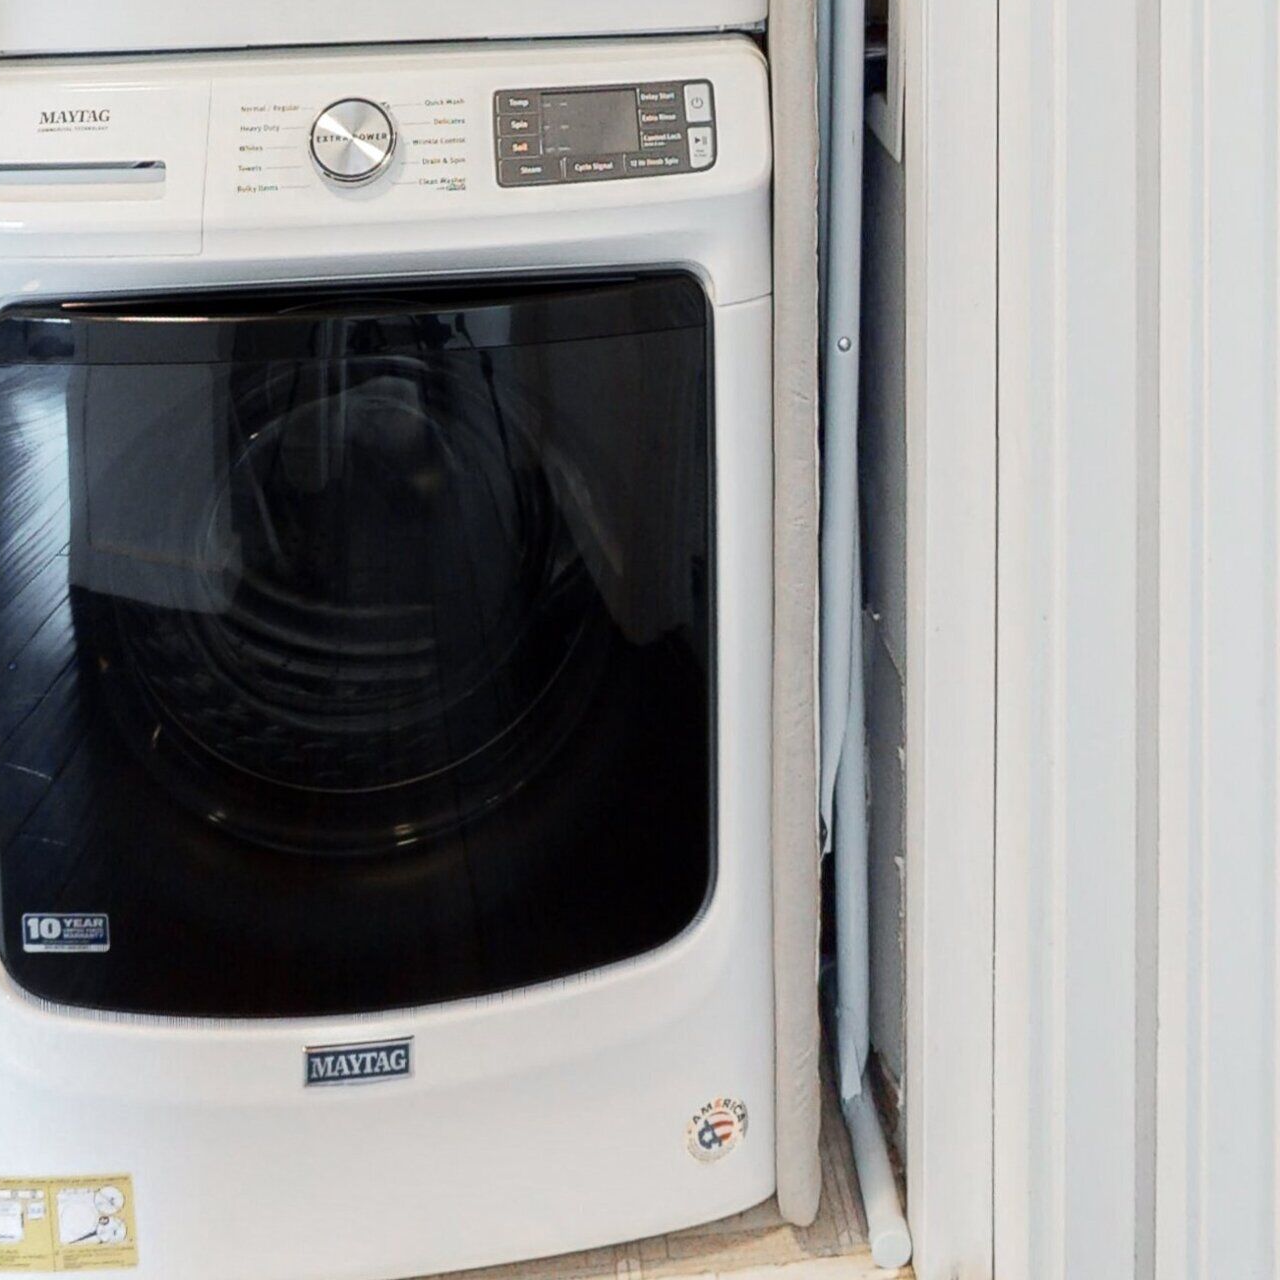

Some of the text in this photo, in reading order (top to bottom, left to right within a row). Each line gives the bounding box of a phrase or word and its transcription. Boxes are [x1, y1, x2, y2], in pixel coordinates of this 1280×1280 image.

[640, 92, 675, 101] Delay Start
[509, 98, 529, 107] Temp
[273, 105, 299, 113] Regular
[38, 109, 110, 125] MAYTAG
[642, 114, 658, 122] Extra
[510, 120, 528, 129] Spin
[316, 132, 387, 143] EXTRA POWER
[643, 132, 682, 141] Control Lock
[512, 142, 528, 152] Soil
[450, 157, 466, 165] Spin
[664, 157, 679, 165] Spin
[520, 166, 542, 174] Steam
[574, 162, 613, 172] Cycle Signal
[237, 185, 256, 193] Bulky
[27, 917, 104, 940] 10 YEAR
[310, 1049, 407, 1079] MAYTAG
